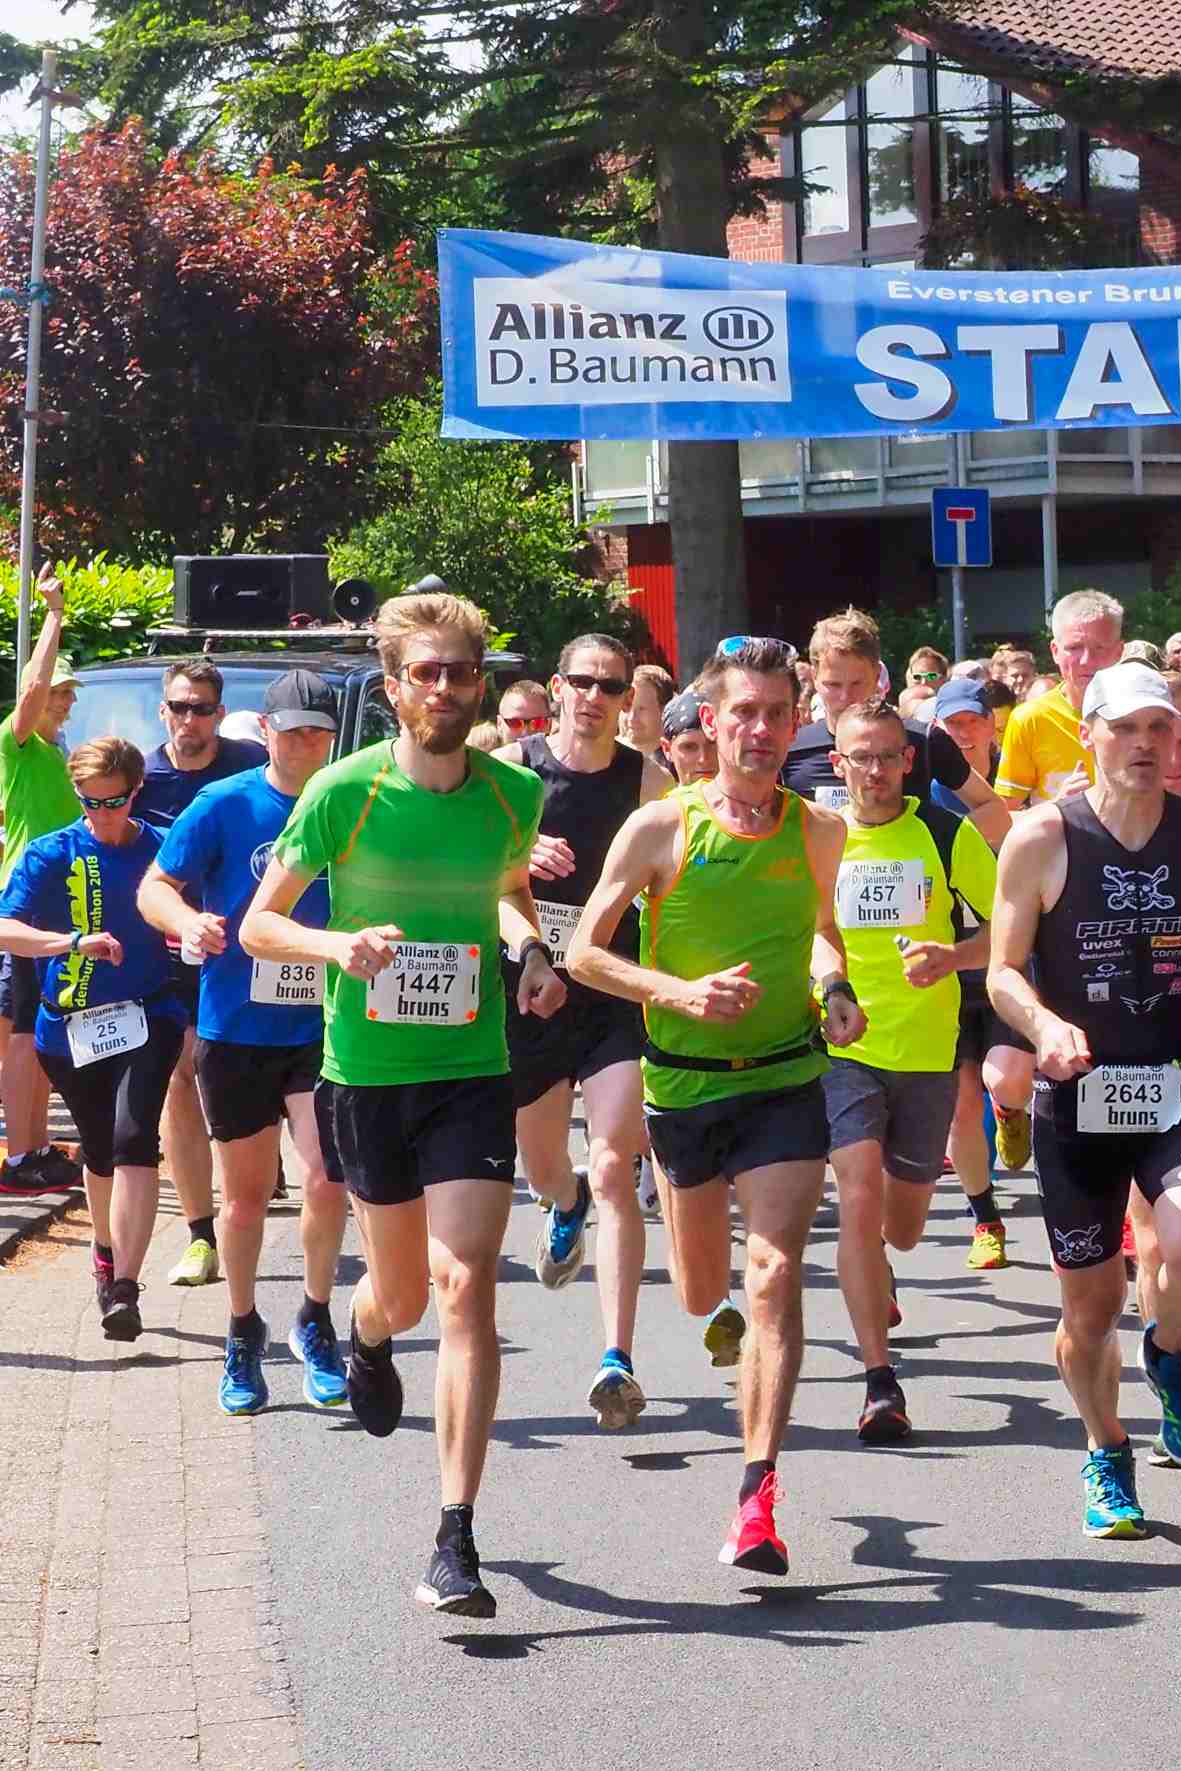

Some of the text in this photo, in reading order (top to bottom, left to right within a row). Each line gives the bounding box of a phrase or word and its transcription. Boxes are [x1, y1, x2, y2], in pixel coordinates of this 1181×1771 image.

[887, 281, 1092, 304] Everstener
[489, 303, 687, 340] Allianz
[490, 348, 776, 385] D. Baumann
[87, 855, 102, 886] 2018
[859, 885, 896, 902] 457
[858, 904, 899, 921] bruns
[394, 945, 440, 959] Allianz
[1083, 939, 1122, 950] uvex
[280, 965, 316, 981] 836
[407, 959, 458, 972] Baumann
[276, 982, 316, 999] bruns
[396, 972, 455, 994] 1447
[397, 994, 450, 1017] bruns
[96, 1021, 117, 1038] 25
[91, 1036, 128, 1055] bruns
[1116, 1070, 1165, 1081] Baumann
[1104, 1083, 1162, 1103] 2643
[1108, 1105, 1158, 1125] bruns
